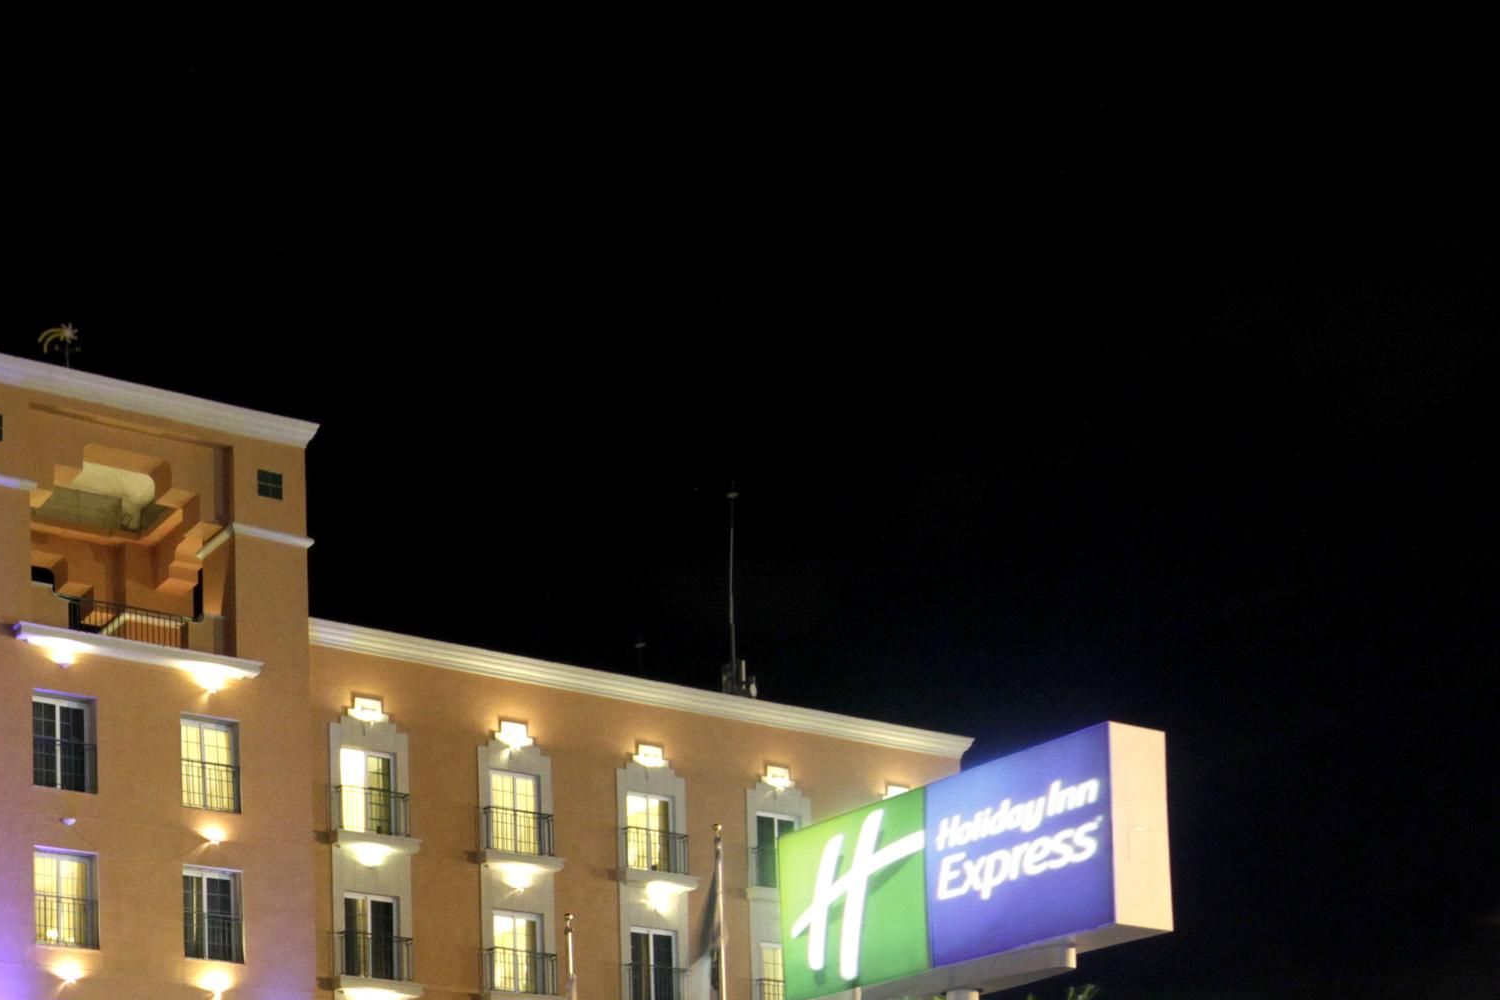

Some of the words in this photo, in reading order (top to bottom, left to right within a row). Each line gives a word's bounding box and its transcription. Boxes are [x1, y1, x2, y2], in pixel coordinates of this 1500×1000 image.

[936, 797, 1046, 851] Holiday
[1046, 779, 1100, 816] Inn
[791, 809, 925, 980] H
[937, 820, 1100, 900] Express
